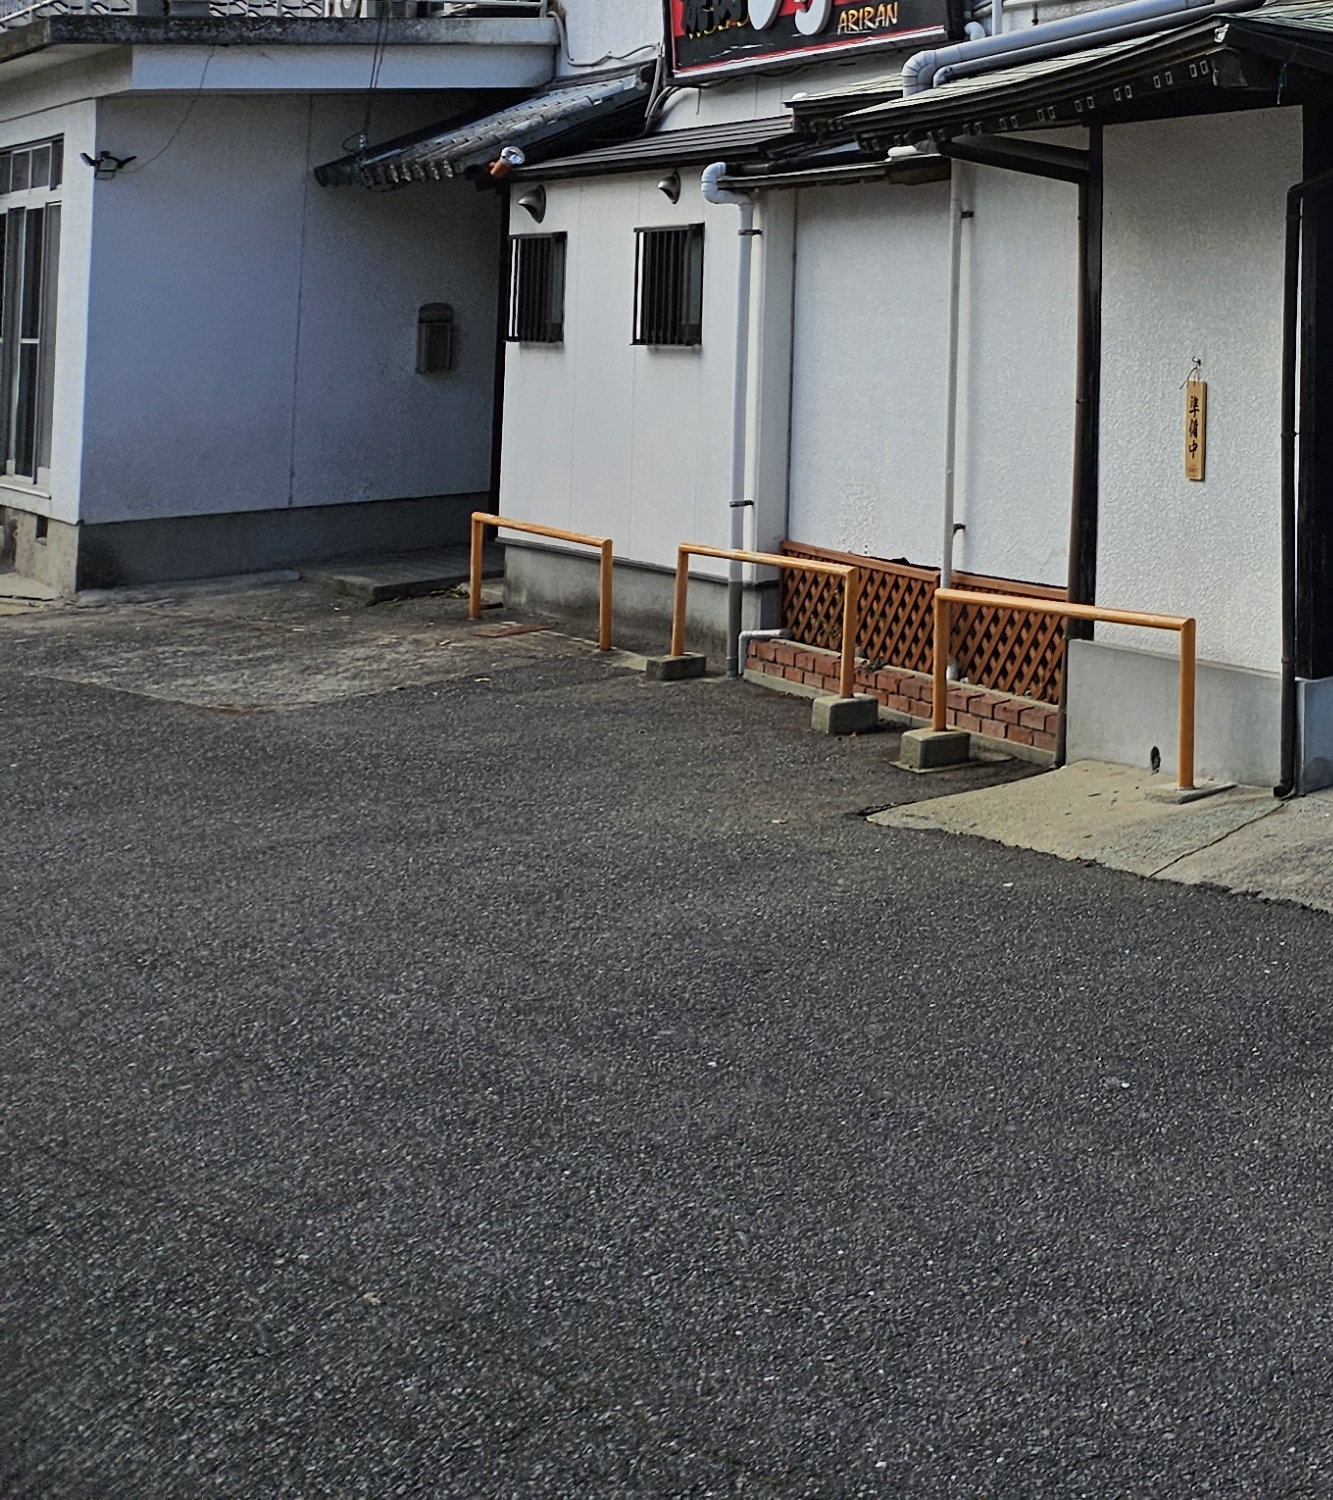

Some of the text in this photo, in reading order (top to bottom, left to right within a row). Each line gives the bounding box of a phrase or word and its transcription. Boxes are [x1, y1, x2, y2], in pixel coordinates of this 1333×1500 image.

[837, 1, 899, 35] ARIRAN
[1188, 395, 1200, 459] 準備中
